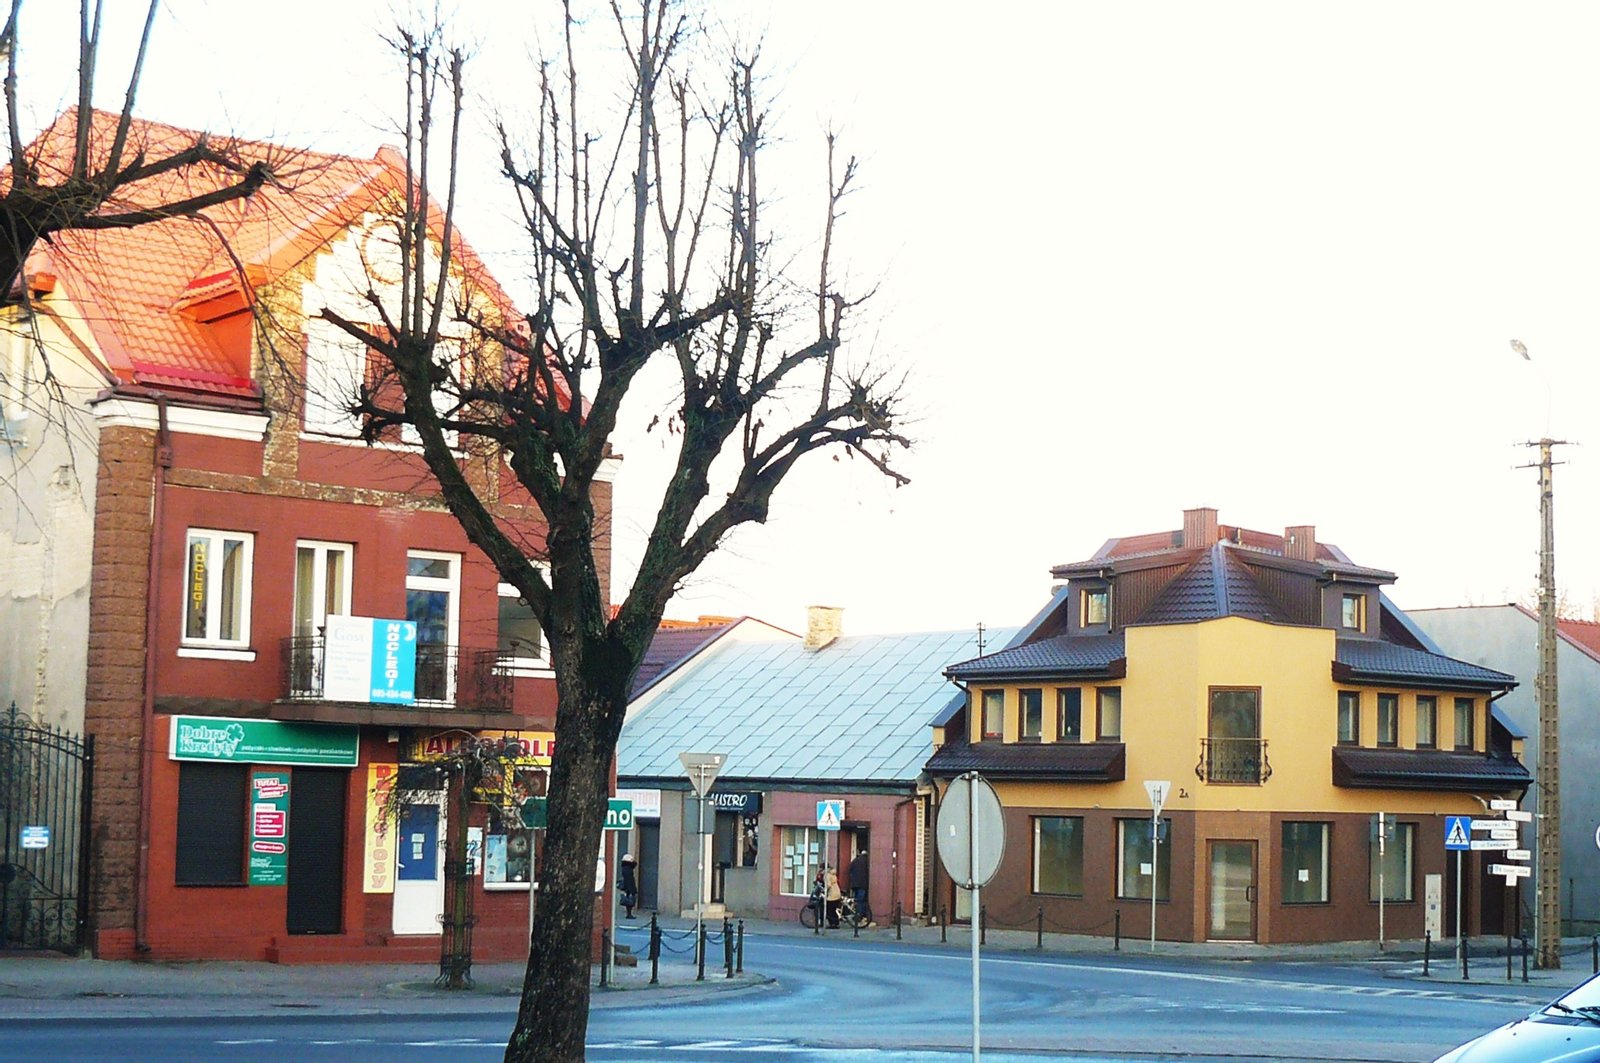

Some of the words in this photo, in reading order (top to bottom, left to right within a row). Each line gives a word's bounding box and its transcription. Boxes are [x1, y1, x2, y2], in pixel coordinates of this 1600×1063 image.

[192, 543, 206, 609] NOCLEGI
[385, 623, 401, 689] NOCLEGI
[180, 738, 238, 757] Kredyty
[181, 724, 227, 741] Dobre
